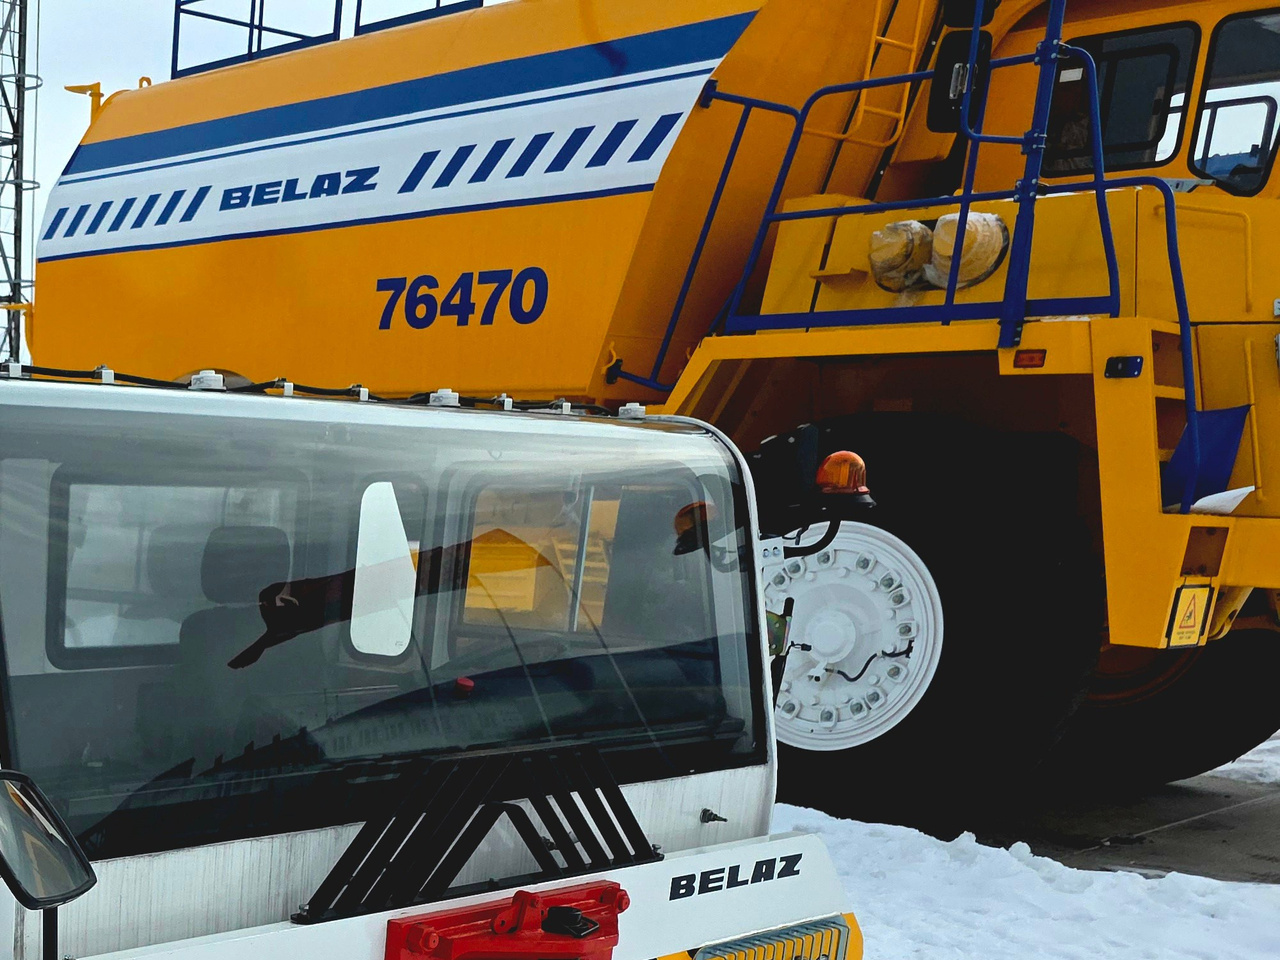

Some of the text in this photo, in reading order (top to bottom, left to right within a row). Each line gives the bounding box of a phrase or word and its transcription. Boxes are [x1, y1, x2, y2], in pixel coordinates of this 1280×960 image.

[219, 166, 380, 211] BELAZ
[375, 266, 549, 330] 76470
[669, 853, 803, 901] BELAZ
